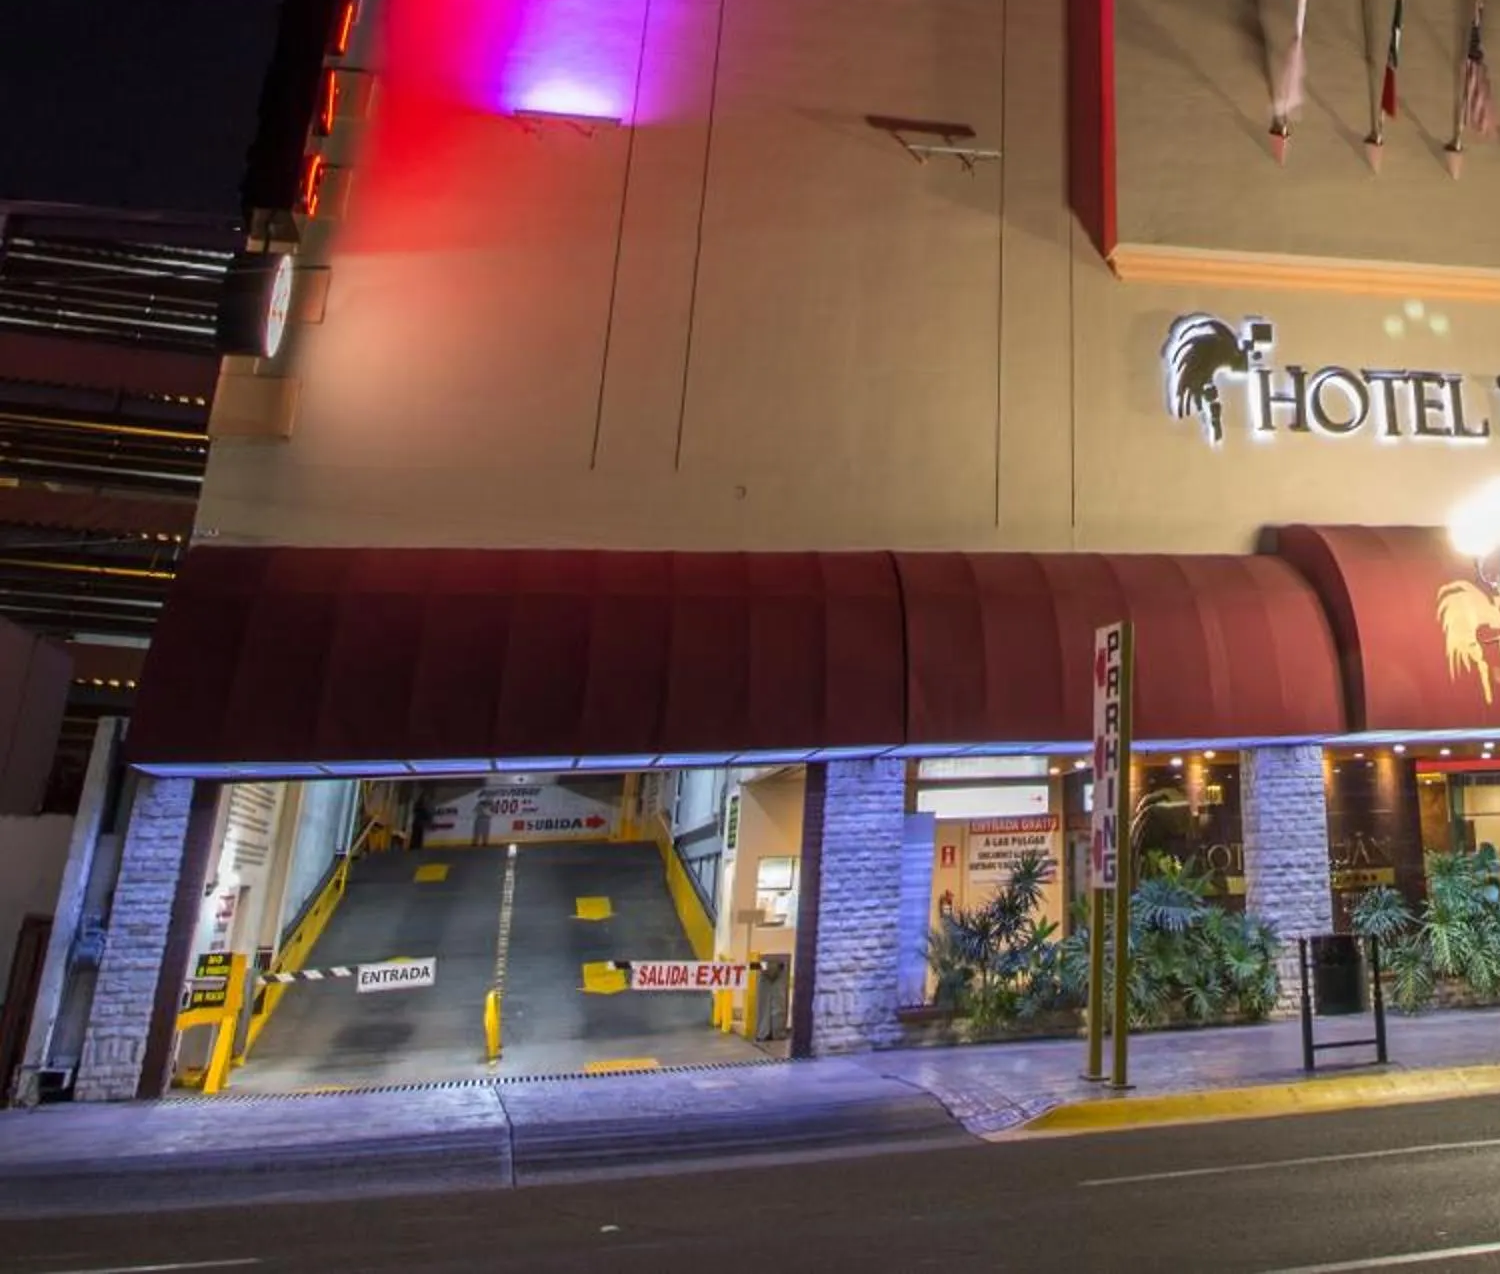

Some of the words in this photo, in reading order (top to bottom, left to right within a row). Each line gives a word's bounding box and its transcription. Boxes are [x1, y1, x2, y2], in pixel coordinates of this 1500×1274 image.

[1253, 365, 1490, 438] HOTEL
[527, 818, 584, 831] SUBIDA
[361, 965, 431, 984] ENTRADA
